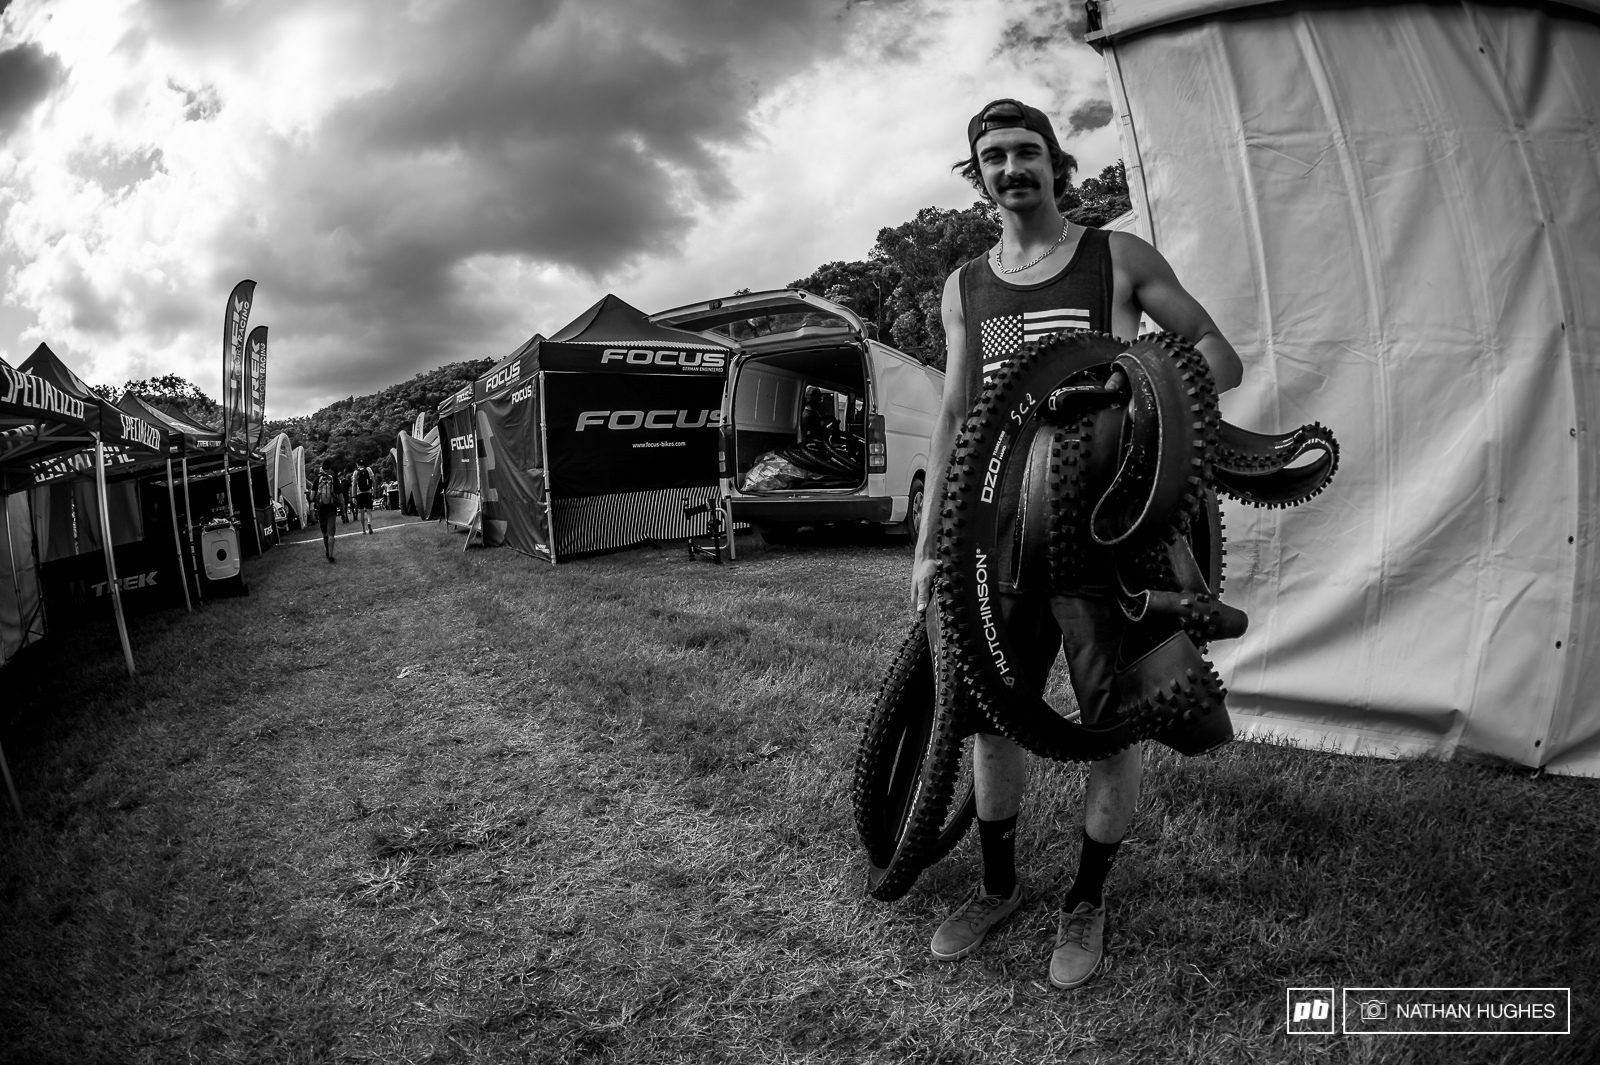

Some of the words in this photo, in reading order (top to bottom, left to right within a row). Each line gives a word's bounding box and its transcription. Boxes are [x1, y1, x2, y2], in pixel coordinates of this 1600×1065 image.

[237, 301, 250, 341] RACING
[601, 348, 725, 367] FOCUS
[1, 364, 85, 419] SPECIALIZED
[251, 338, 261, 416] TREK
[486, 359, 521, 393] FOCUS
[511, 384, 532, 405] FOCUS
[120, 413, 161, 451] SPECIALIZED
[575, 409, 722, 432] FOCUS
[451, 433, 474, 451] FOCUS
[632, 440, 686, 449] www.focus-bikes.com
[980, 457, 1001, 504] DZO
[975, 553, 1010, 675] HUTCHINSON
